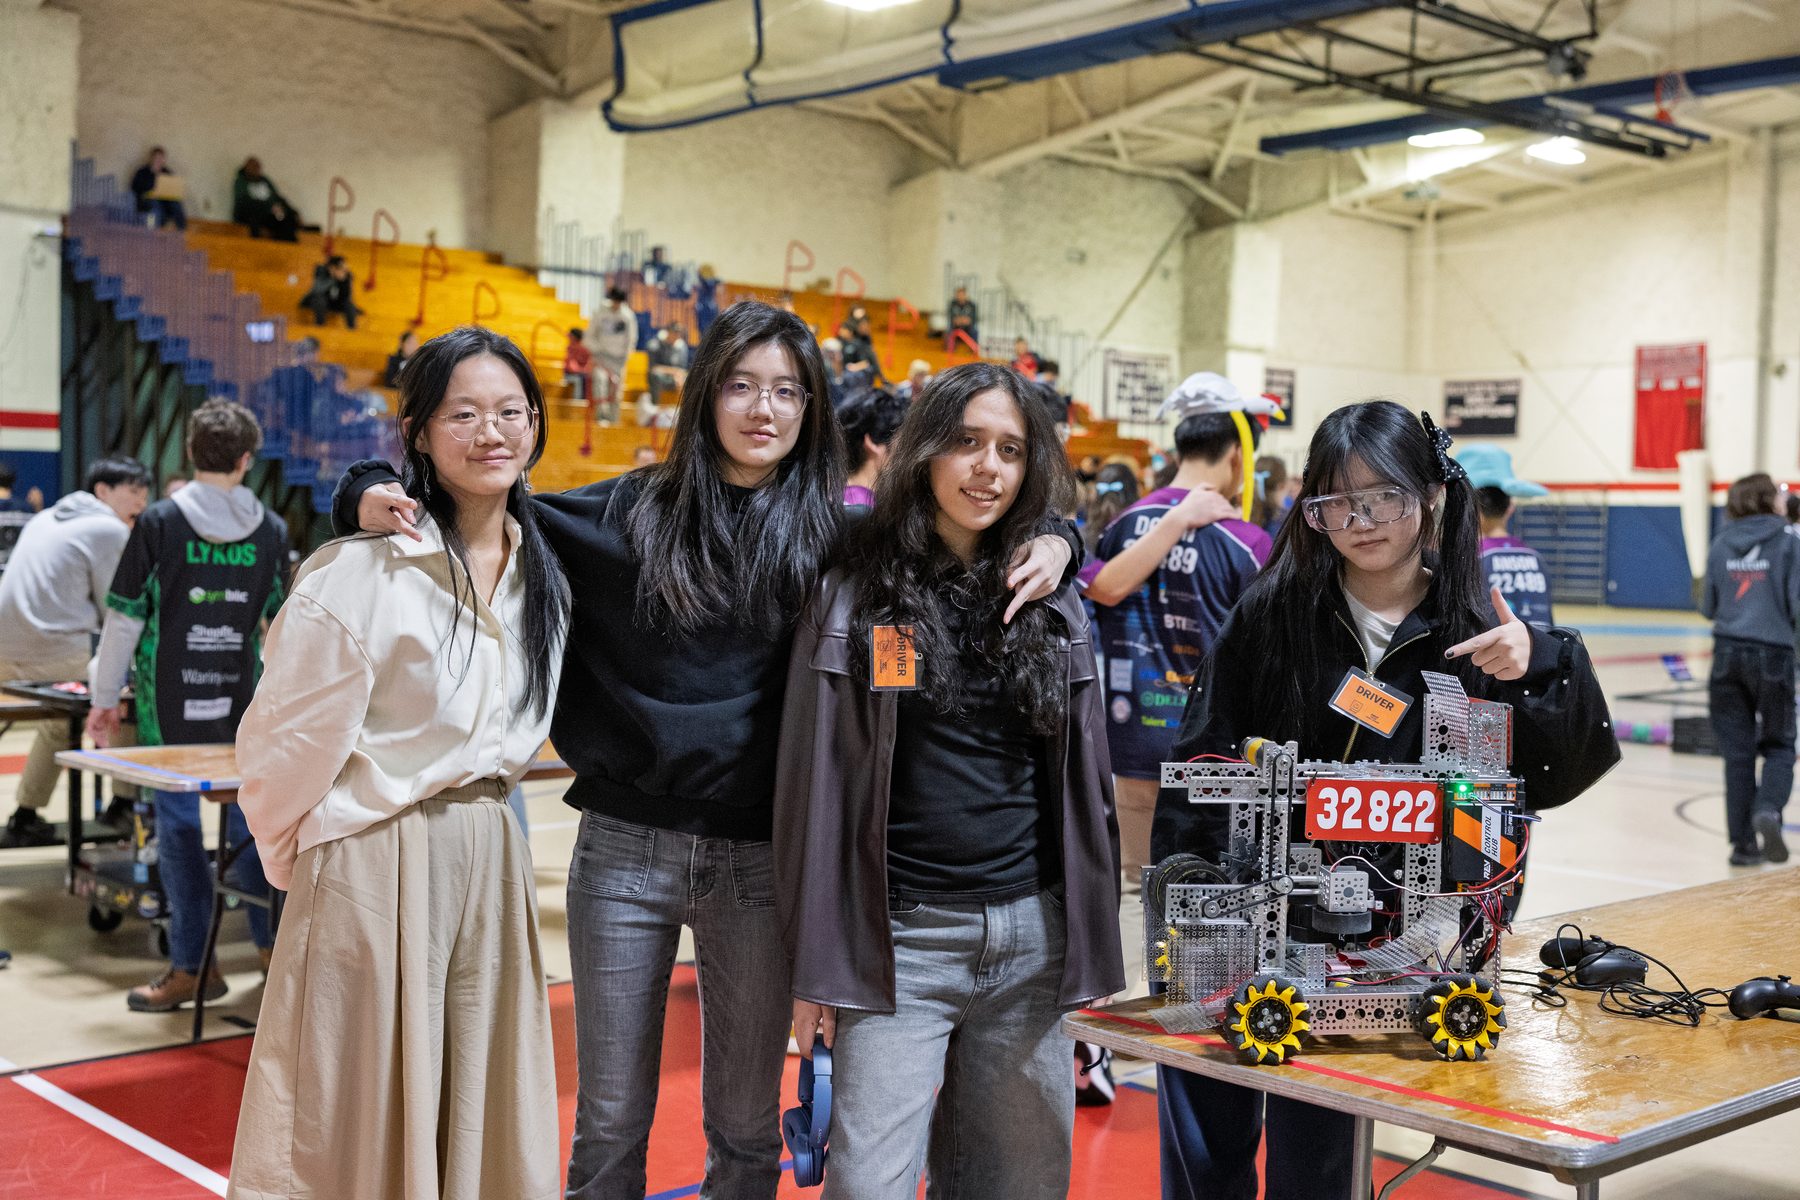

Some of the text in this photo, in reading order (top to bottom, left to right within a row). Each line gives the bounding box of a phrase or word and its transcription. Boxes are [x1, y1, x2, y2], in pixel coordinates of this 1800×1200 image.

[186, 541, 257, 567] LYKOS
[897, 637, 906, 676] DRIVER
[1355, 685, 1395, 712] DRIVER
[1316, 786, 1436, 833] 32822
[1484, 816, 1492, 854] CONTROL
[1483, 859, 1491, 880] REV
